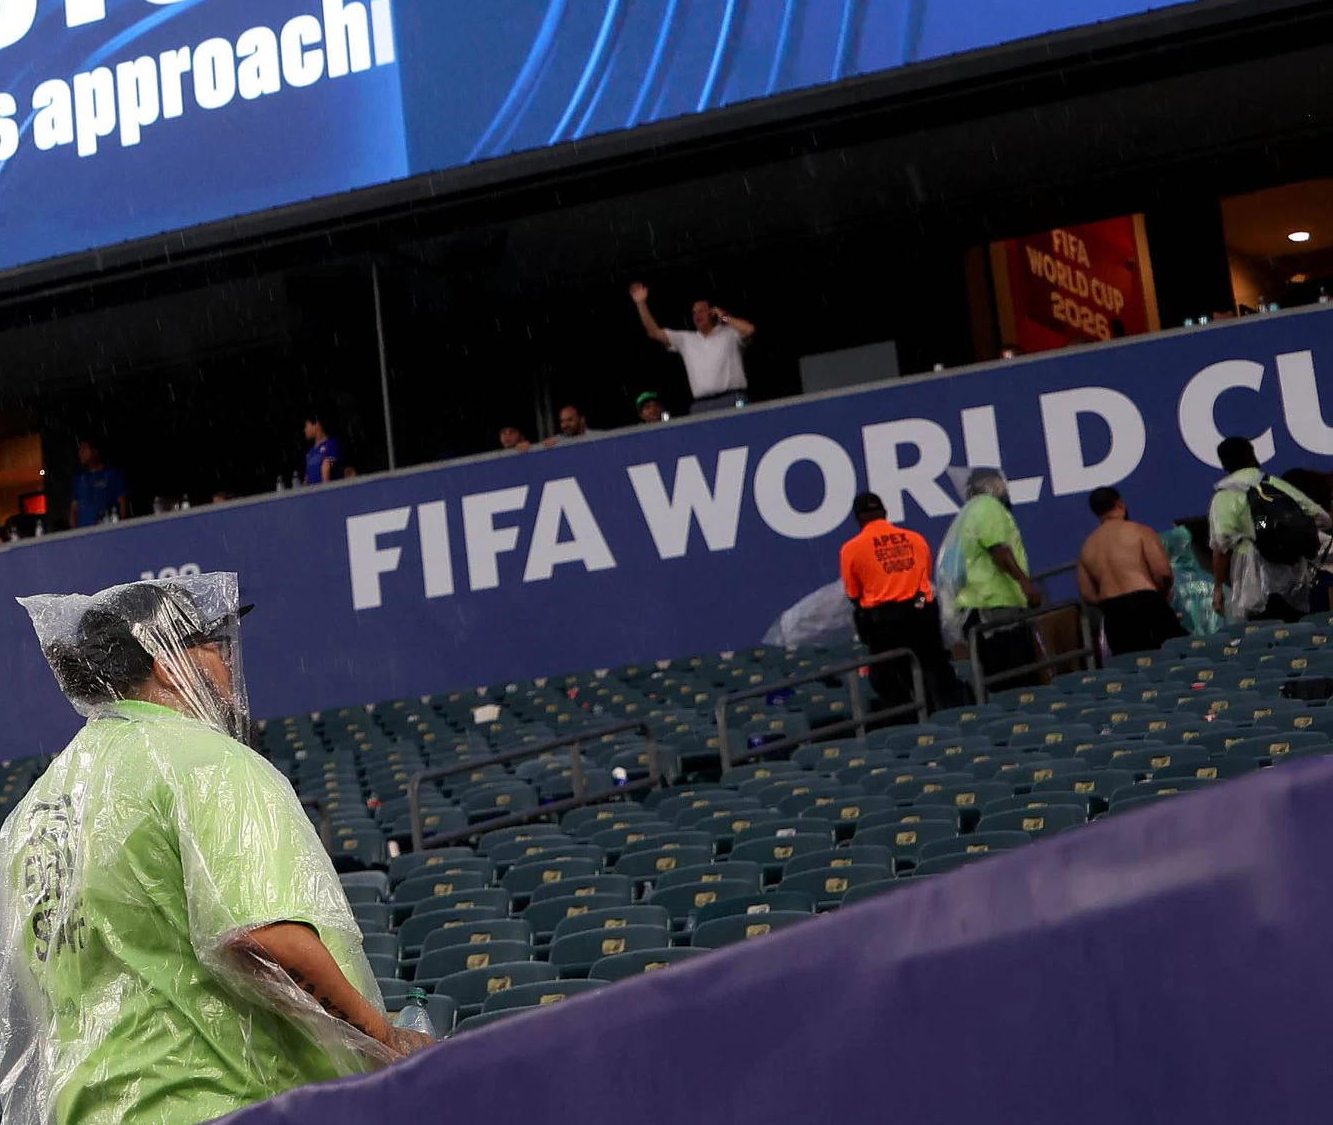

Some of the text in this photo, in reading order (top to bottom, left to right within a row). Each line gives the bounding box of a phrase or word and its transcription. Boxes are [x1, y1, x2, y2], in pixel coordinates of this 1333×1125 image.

[1050, 228, 1090, 269] FIFA
[1025, 245, 1125, 313] WORLD CUP
[1050, 291, 1112, 342] 2026
[346, 476, 617, 611] FIFA
[628, 386, 1147, 561] WORLD
[874, 533, 909, 547] APEX
